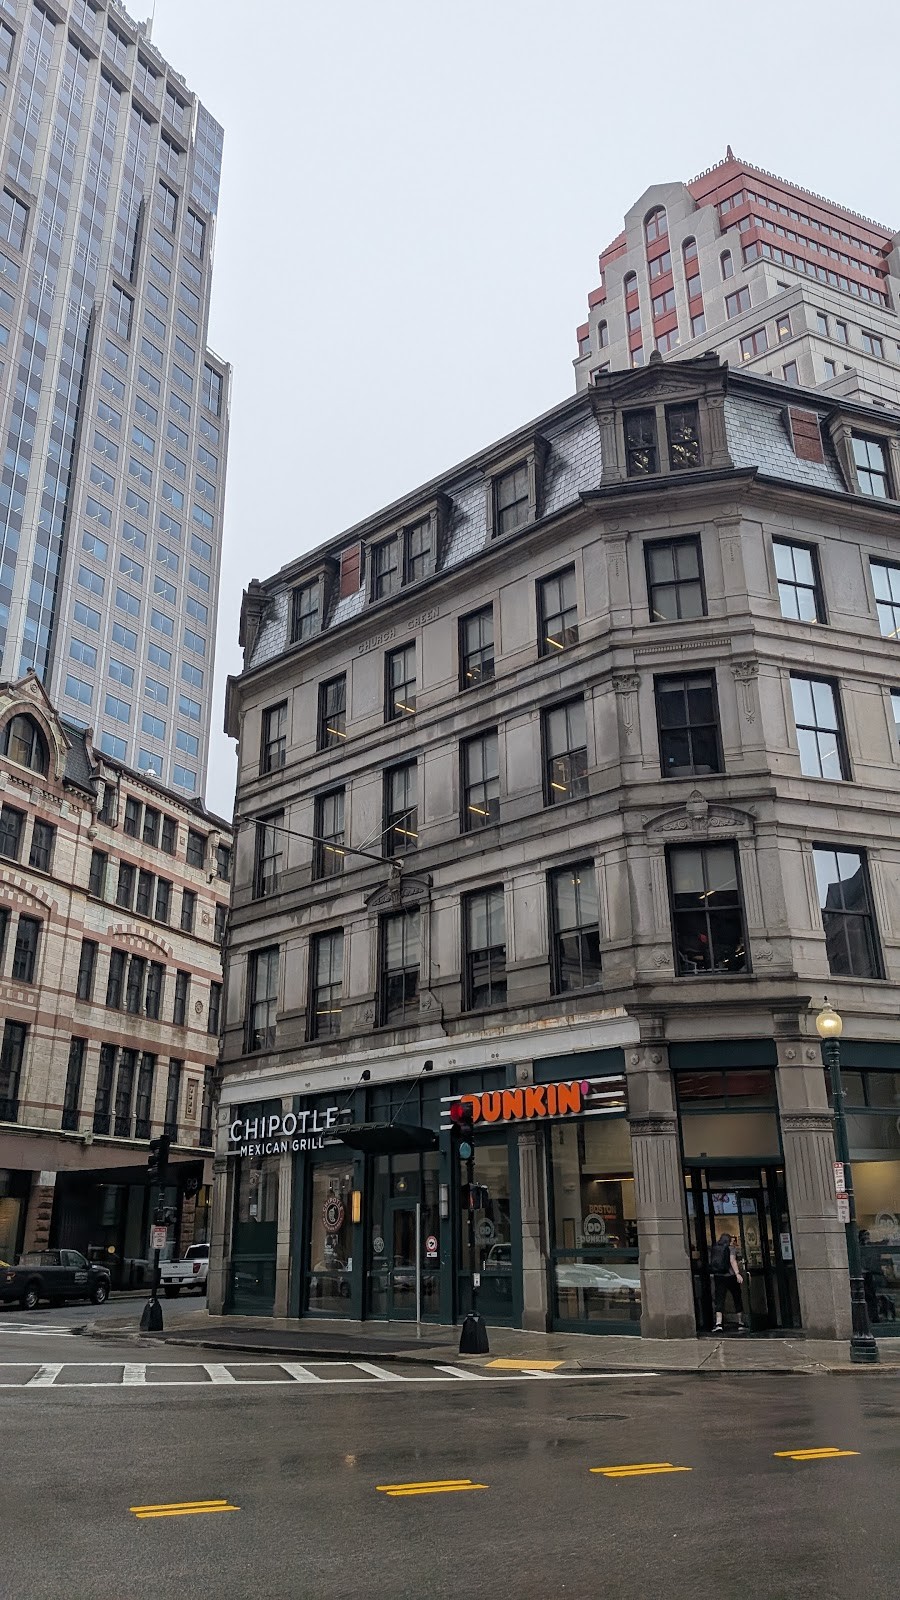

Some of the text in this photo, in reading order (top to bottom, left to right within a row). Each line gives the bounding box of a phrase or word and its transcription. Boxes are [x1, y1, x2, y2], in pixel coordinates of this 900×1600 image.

[358, 627, 397, 654] CHURCH
[230, 1106, 339, 1142] CHIPOTLE
[240, 1136, 325, 1157] MEXICAN GRILL
[589, 1204, 617, 1214] BOSTON
